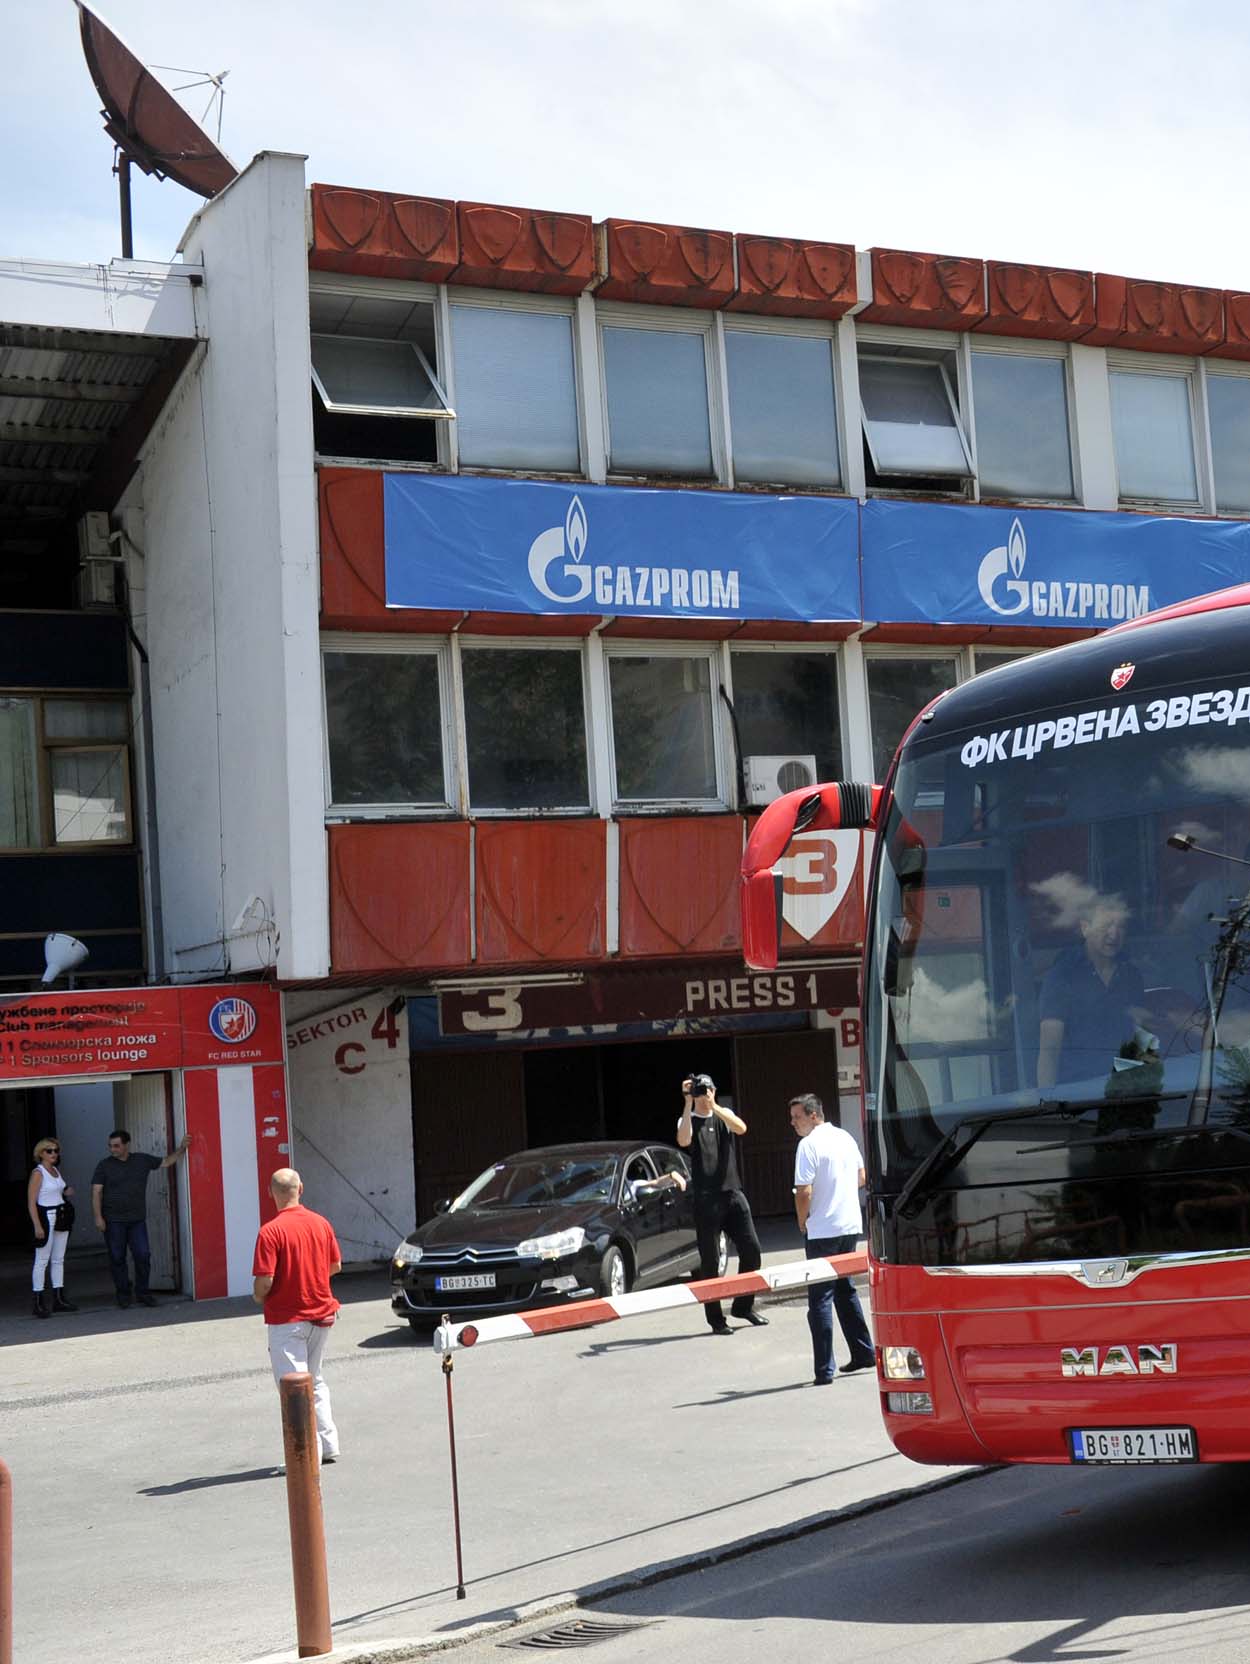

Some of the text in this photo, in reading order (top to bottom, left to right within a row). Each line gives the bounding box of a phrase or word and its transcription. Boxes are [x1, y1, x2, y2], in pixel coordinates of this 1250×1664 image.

[594, 565, 740, 609] GAZPROM
[1031, 581, 1149, 619] GAZPROM
[960, 728, 1014, 768] ФК
[1010, 703, 1140, 761] ЦРВЕНА
[782, 839, 838, 895] 3
[461, 980, 523, 1031] 3
[685, 973, 818, 1012] PRESS 1
[116, 1034, 157, 1046] ложа
[287, 1006, 400, 1049] SEKTOR 4
[22, 1051, 93, 1067] Sponsors
[97, 1048, 148, 1062] lounge
[208, 1049, 262, 1060] FC RED STAR
[335, 1042, 366, 1074] C
[442, 1277, 454, 1289] BG
[1060, 1343, 1177, 1377] MAN
[1085, 1434, 1109, 1457] BG
